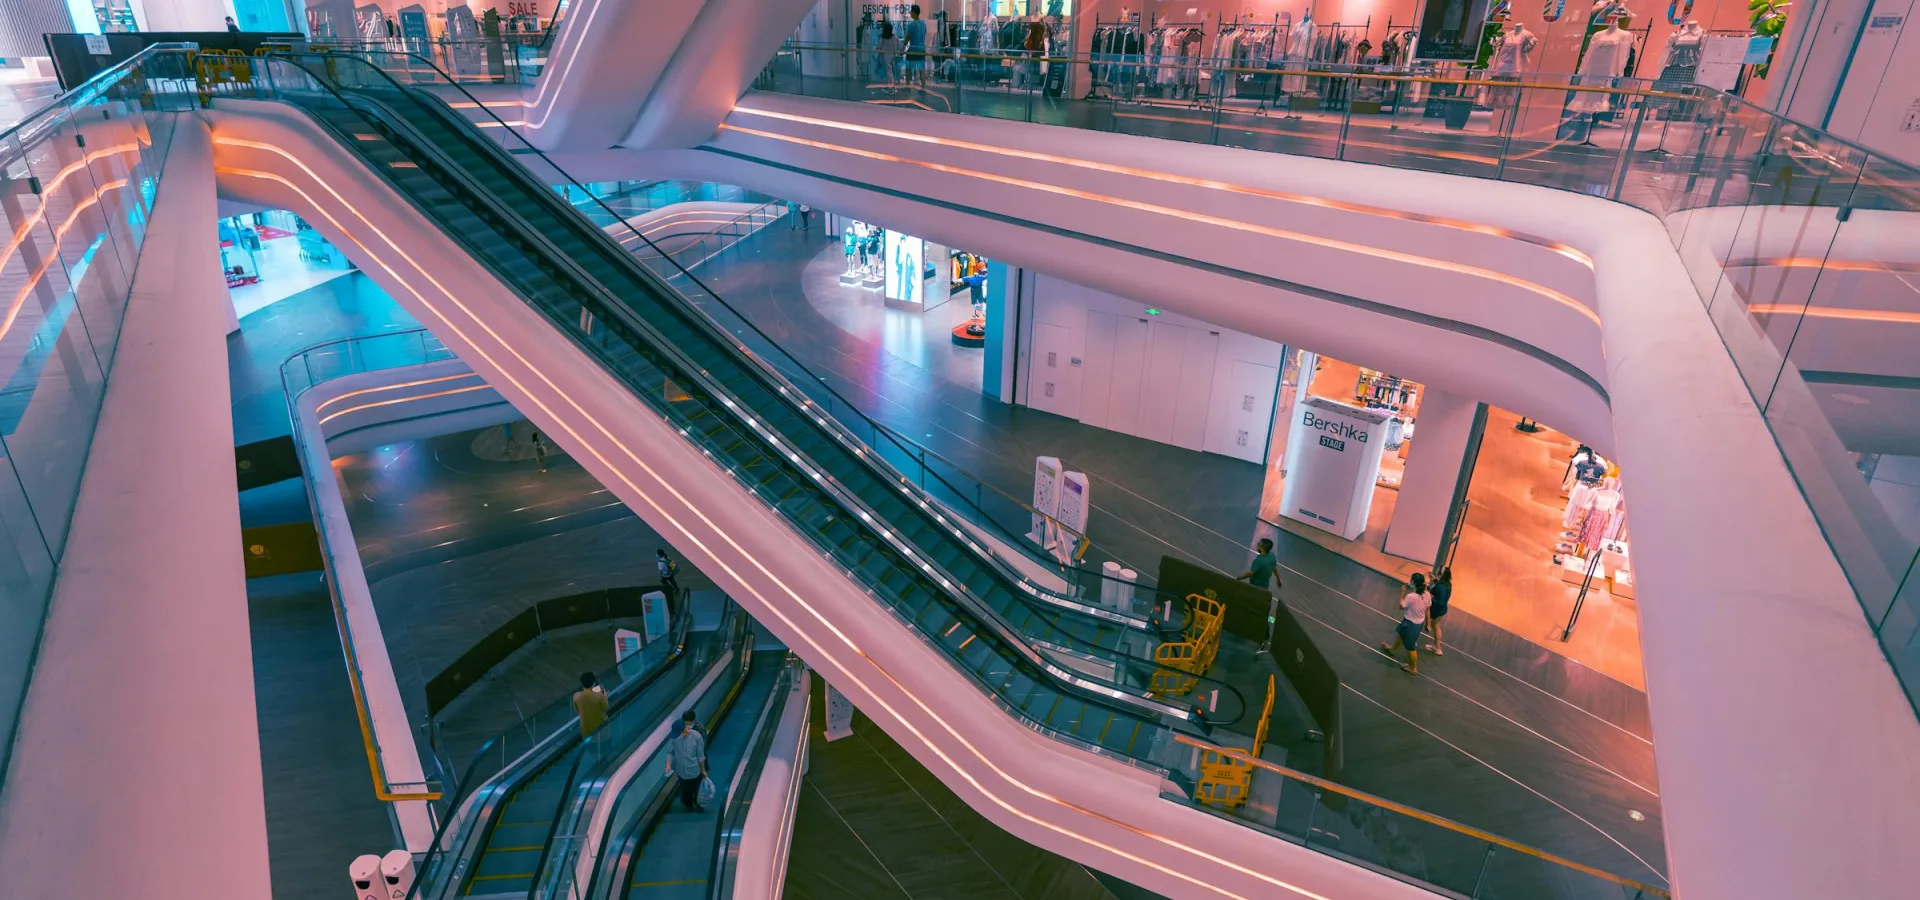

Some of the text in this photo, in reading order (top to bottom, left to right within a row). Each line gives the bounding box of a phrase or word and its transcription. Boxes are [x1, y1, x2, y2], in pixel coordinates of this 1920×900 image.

[508, 2, 538, 15] SALE
[862, 4, 889, 14] DESIGN
[1302, 411, 1368, 443] Bershka
[1320, 436, 1344, 451] STAGE
